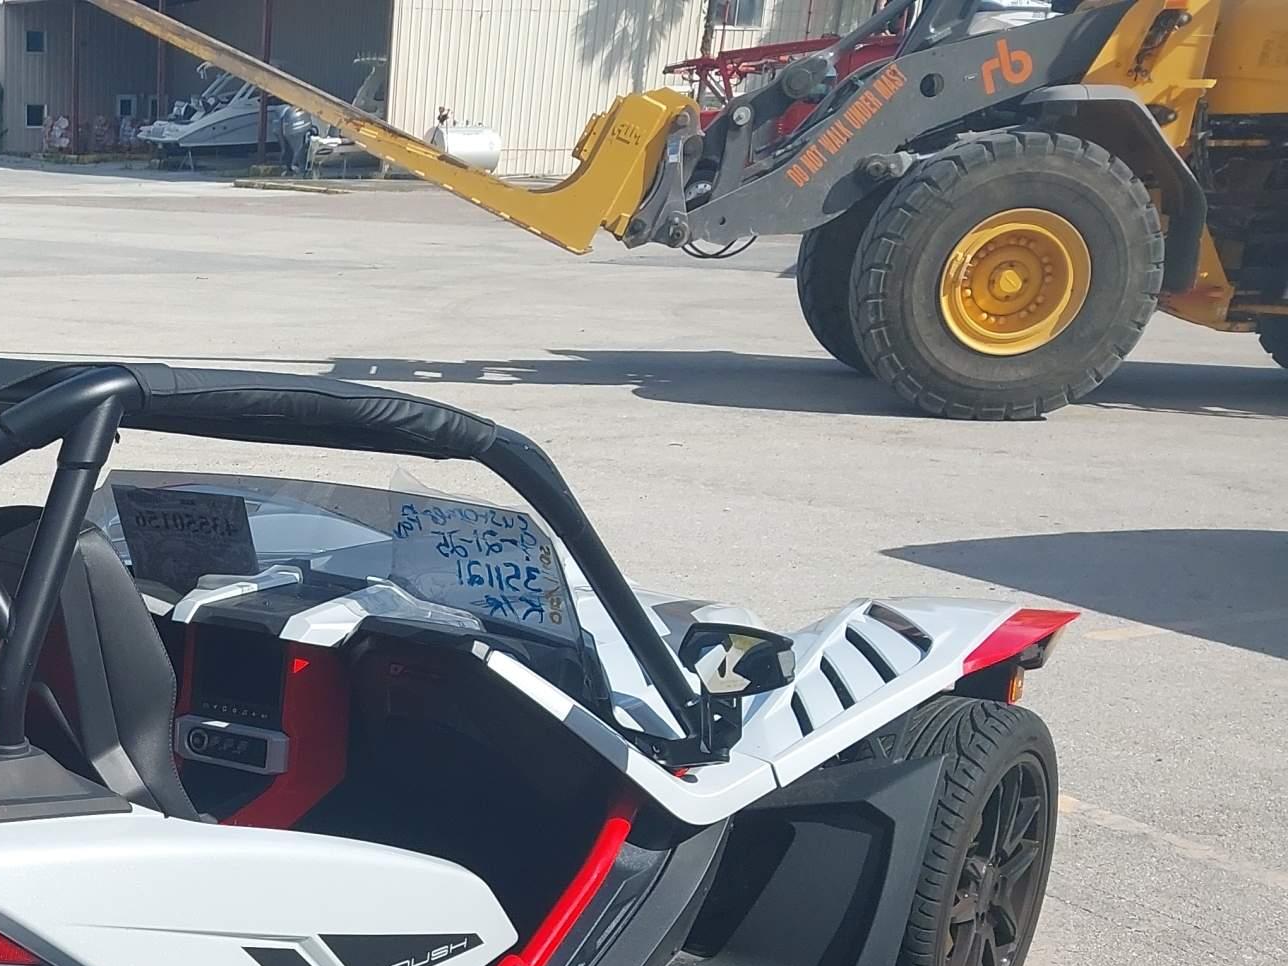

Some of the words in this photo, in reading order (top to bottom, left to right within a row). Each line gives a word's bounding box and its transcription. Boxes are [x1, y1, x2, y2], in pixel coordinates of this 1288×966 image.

[982, 39, 1033, 95] rb
[786, 163, 810, 188] DO
[800, 144, 828, 174] NOT
[818, 119, 854, 155] WALK
[844, 90, 883, 129] UNDER
[872, 63, 907, 100] MAST
